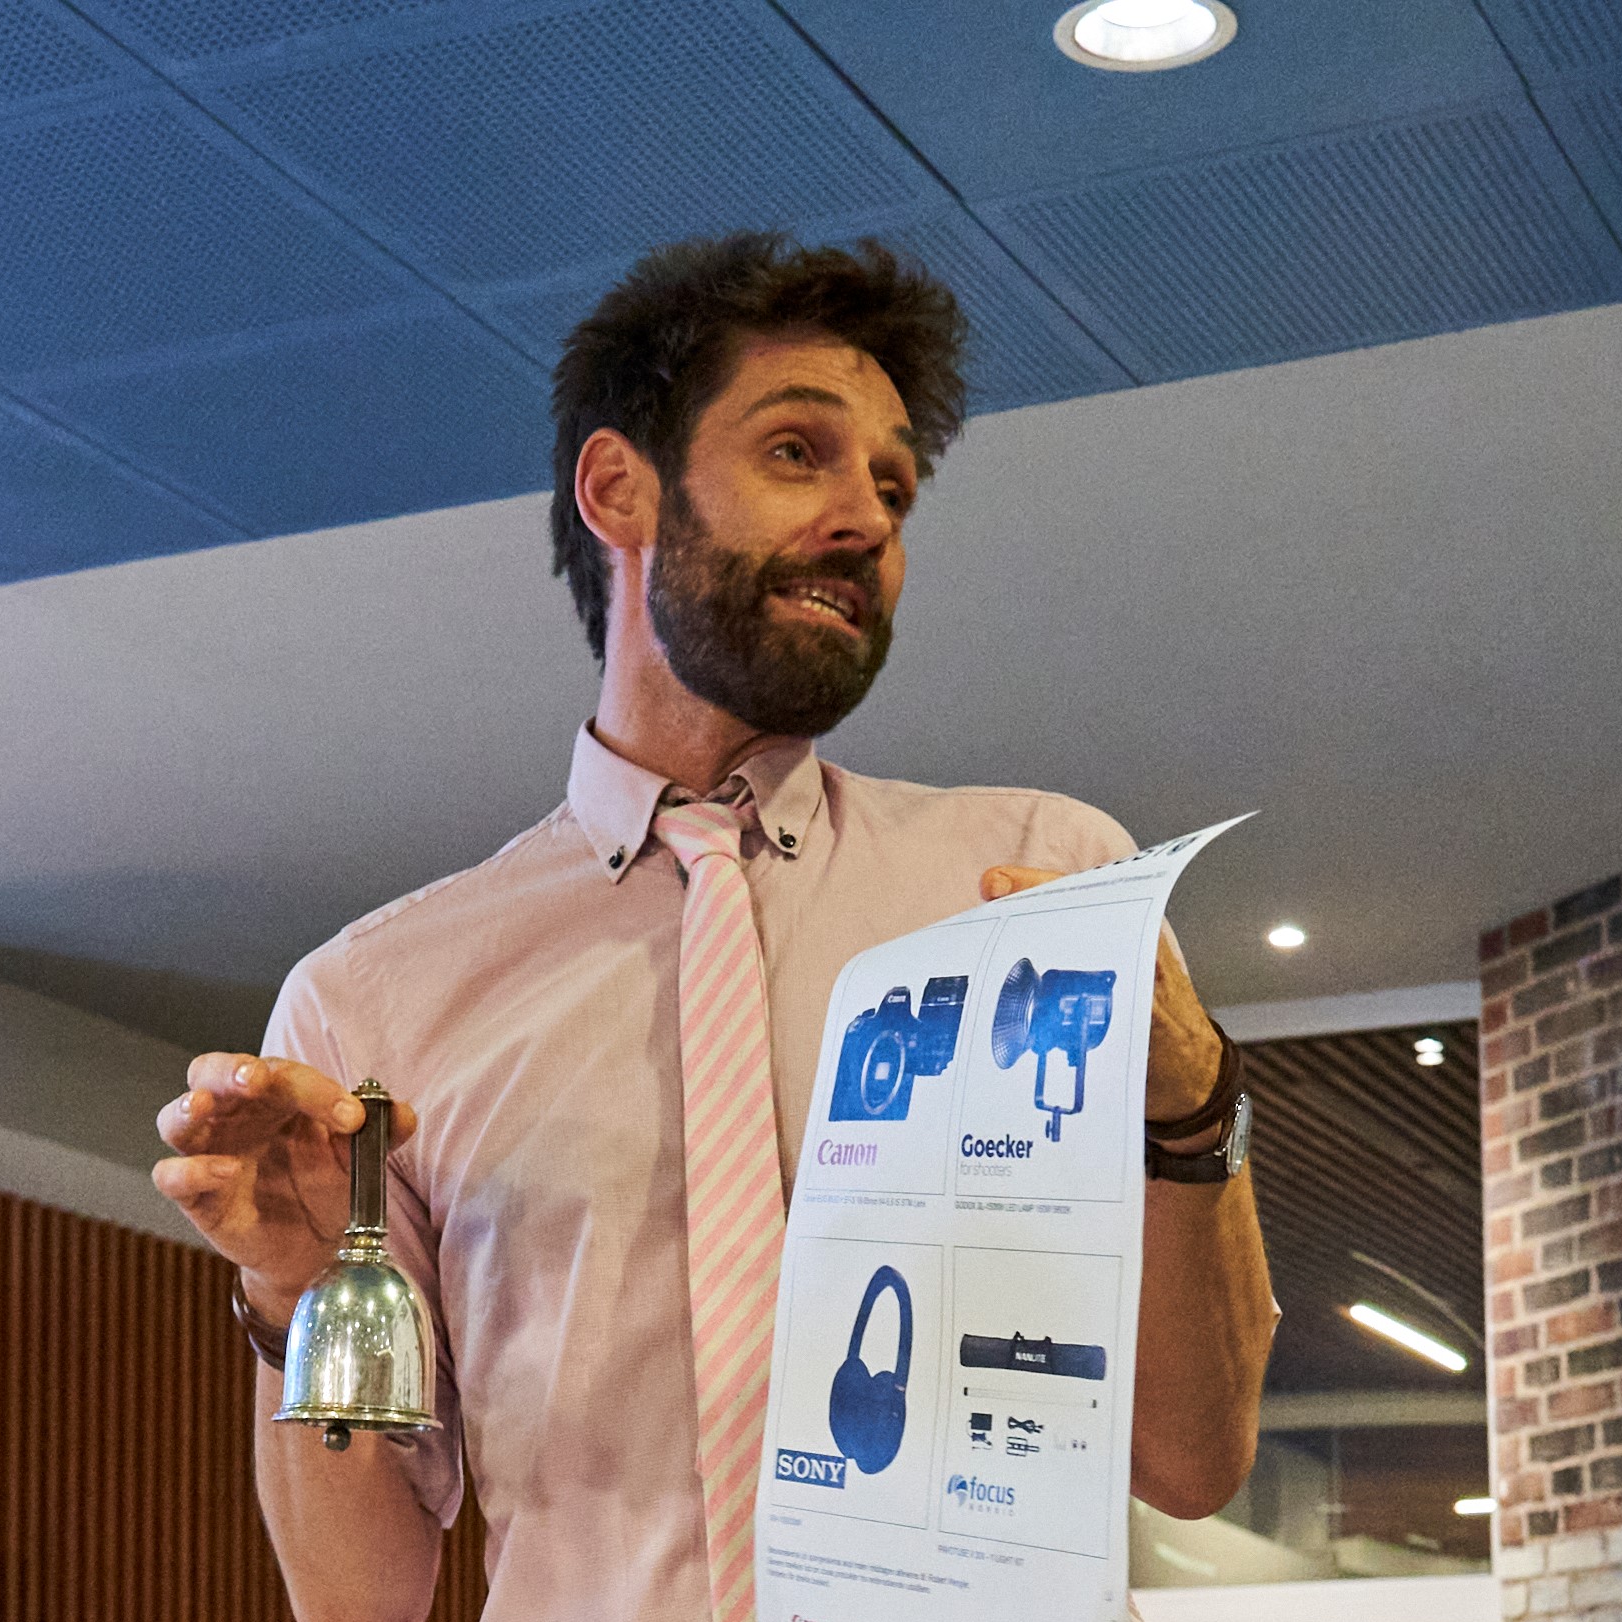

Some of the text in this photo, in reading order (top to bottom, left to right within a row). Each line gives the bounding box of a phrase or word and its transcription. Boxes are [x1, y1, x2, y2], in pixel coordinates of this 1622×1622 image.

[817, 1139, 878, 1166] Canon
[961, 1133, 1034, 1158] Goecker
[777, 1454, 845, 1483] SONY
[969, 1476, 1016, 1506] focus
